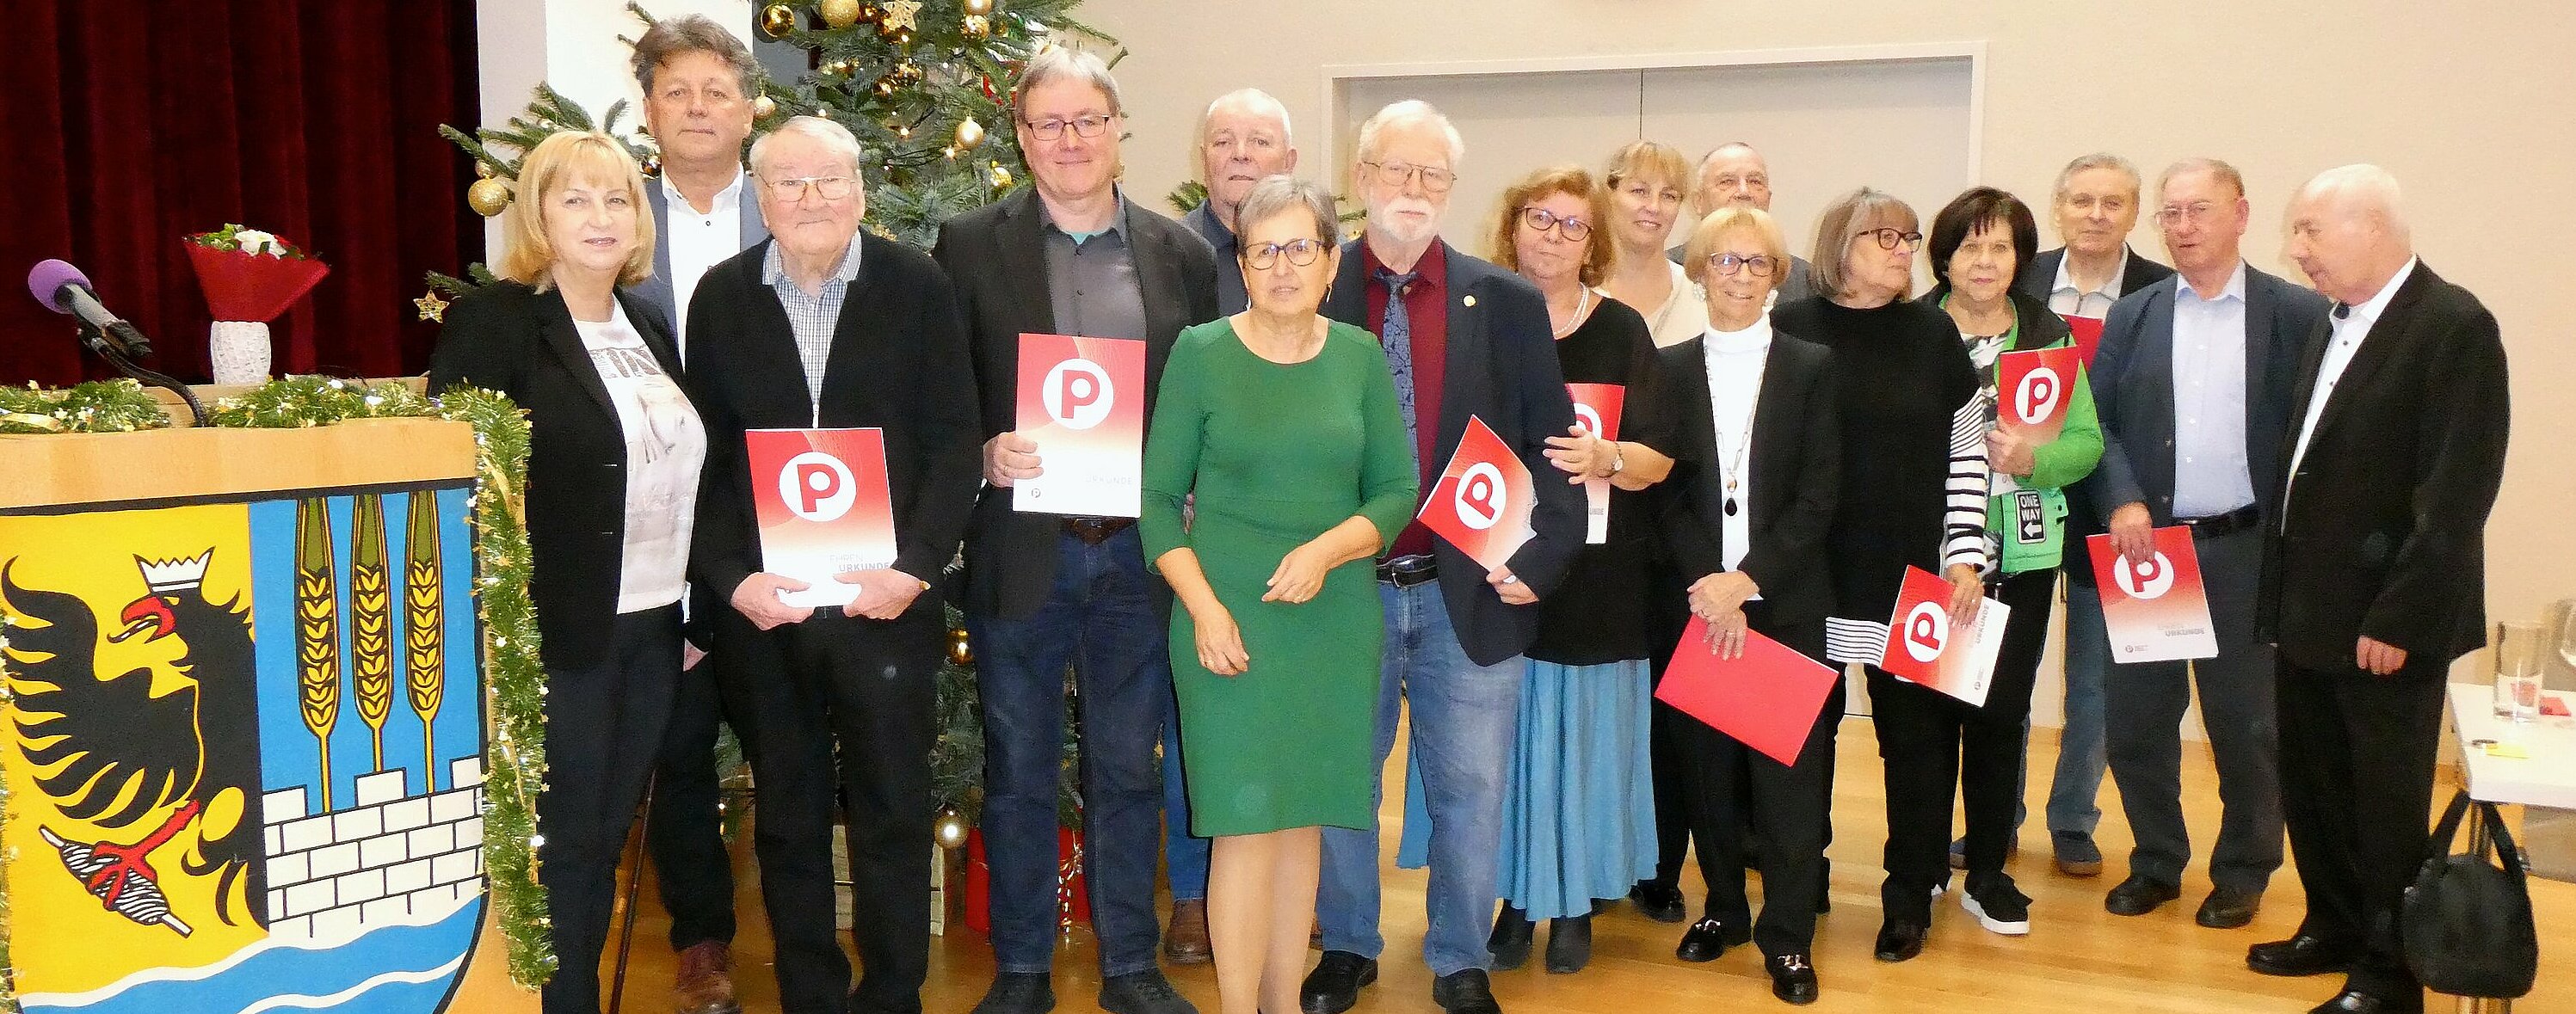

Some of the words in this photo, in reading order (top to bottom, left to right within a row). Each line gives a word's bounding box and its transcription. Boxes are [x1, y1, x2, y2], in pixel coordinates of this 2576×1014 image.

[1061, 370, 1100, 419] P
[2027, 377, 2052, 417] P
[798, 463, 841, 513] P
[1461, 473, 1495, 520] P
[2019, 495, 2039, 507] ONE
[2021, 508, 2041, 521] WAY
[839, 562, 891, 573] URKUNDE
[1910, 611, 1940, 650] P
